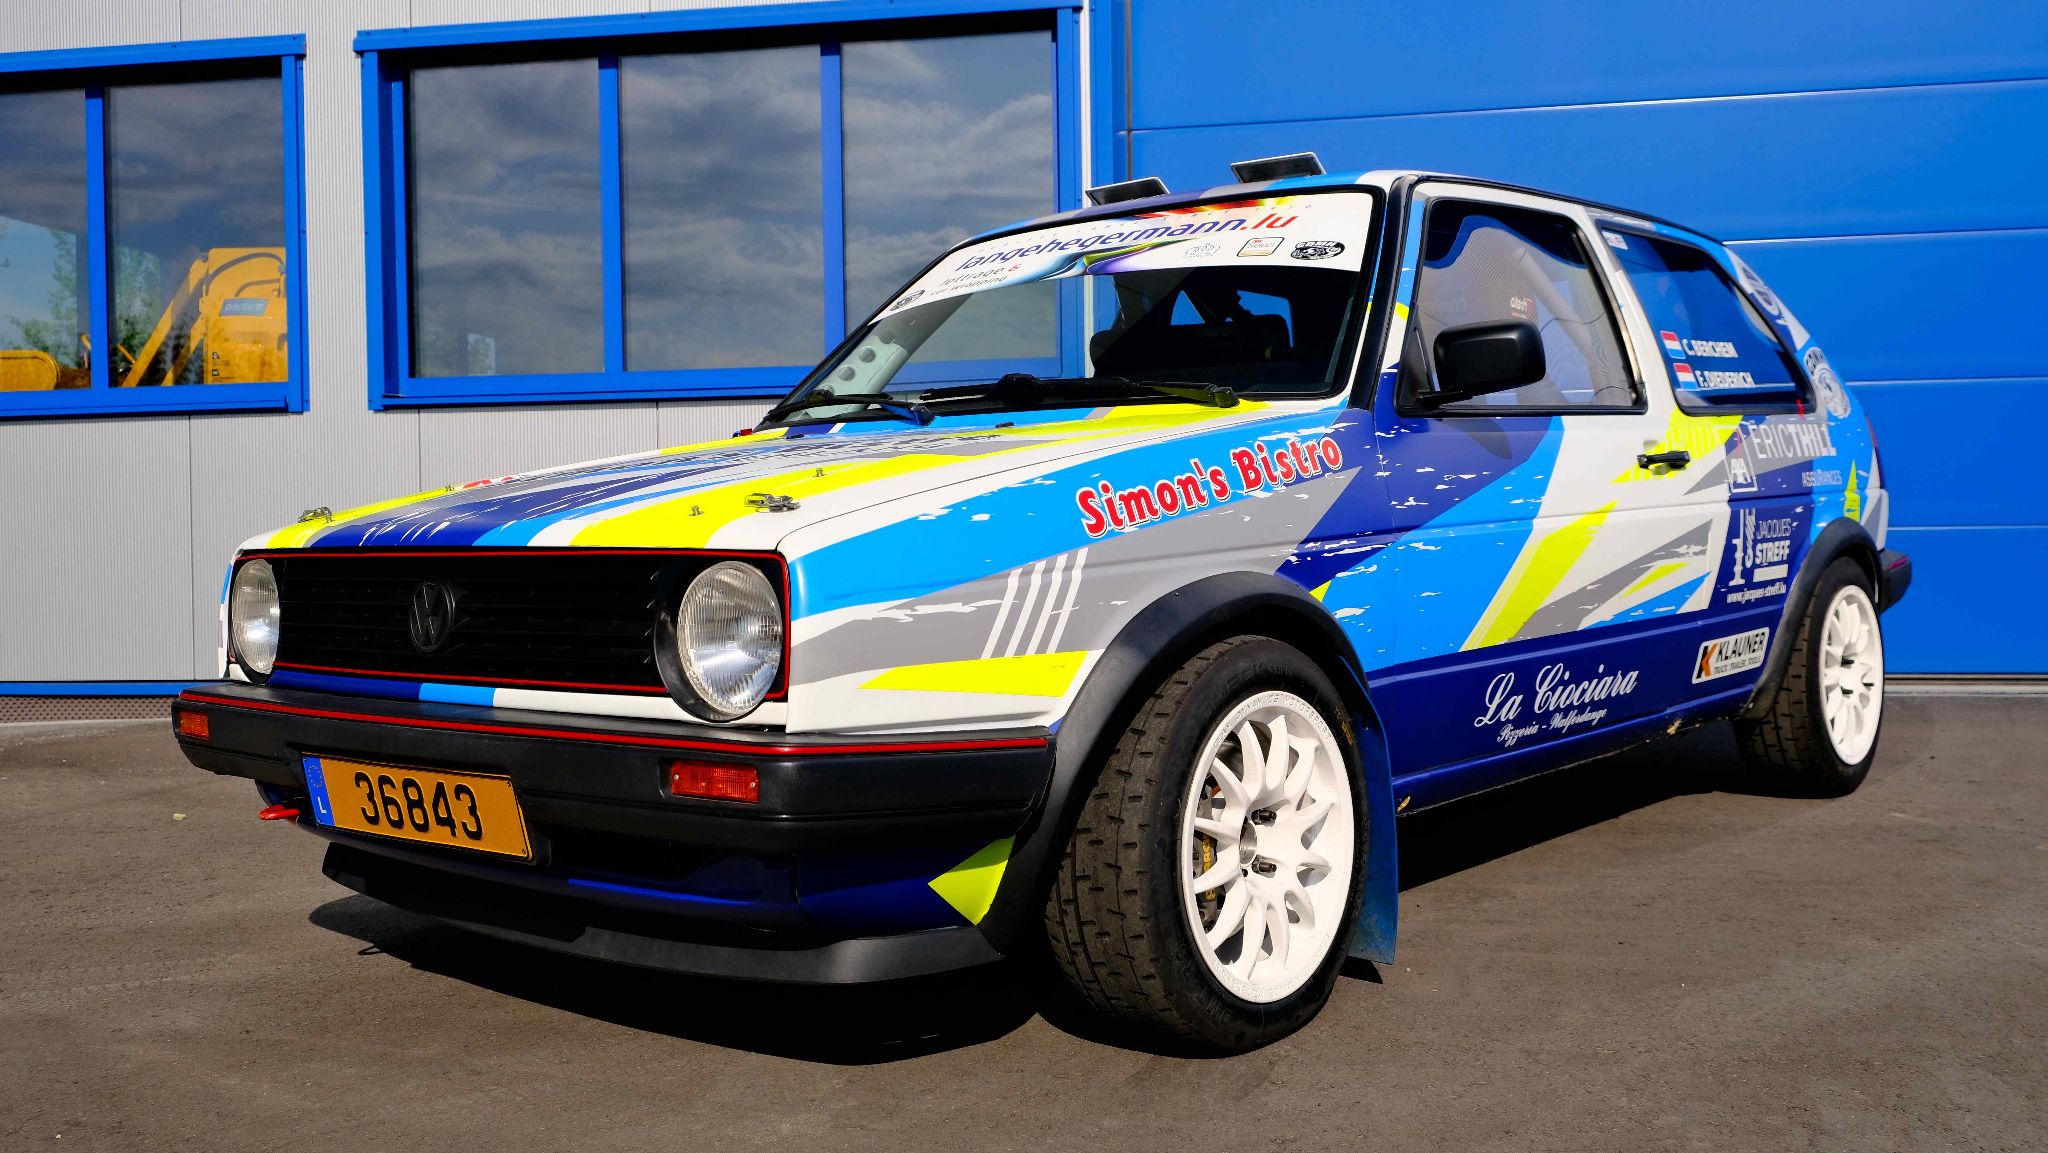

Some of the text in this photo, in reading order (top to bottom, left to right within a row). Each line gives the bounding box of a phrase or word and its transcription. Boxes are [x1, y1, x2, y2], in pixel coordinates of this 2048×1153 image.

[955, 213, 1299, 272] langehegermann.lu
[940, 267, 1005, 286] lettrage
[951, 275, 1008, 291] wrapping
[1076, 436, 1343, 537] Simon's Bistro
[1756, 518, 1792, 539] JACQUES
[1755, 540, 1790, 565] STREFF
[1717, 632, 1766, 663] KLAUNER
[1474, 663, 1639, 727] La Ciociara
[1497, 721, 1539, 747] Pizzeria
[1549, 706, 1608, 733] Walferdange
[317, 797, 327, 814] L
[354, 771, 483, 841] 36843
